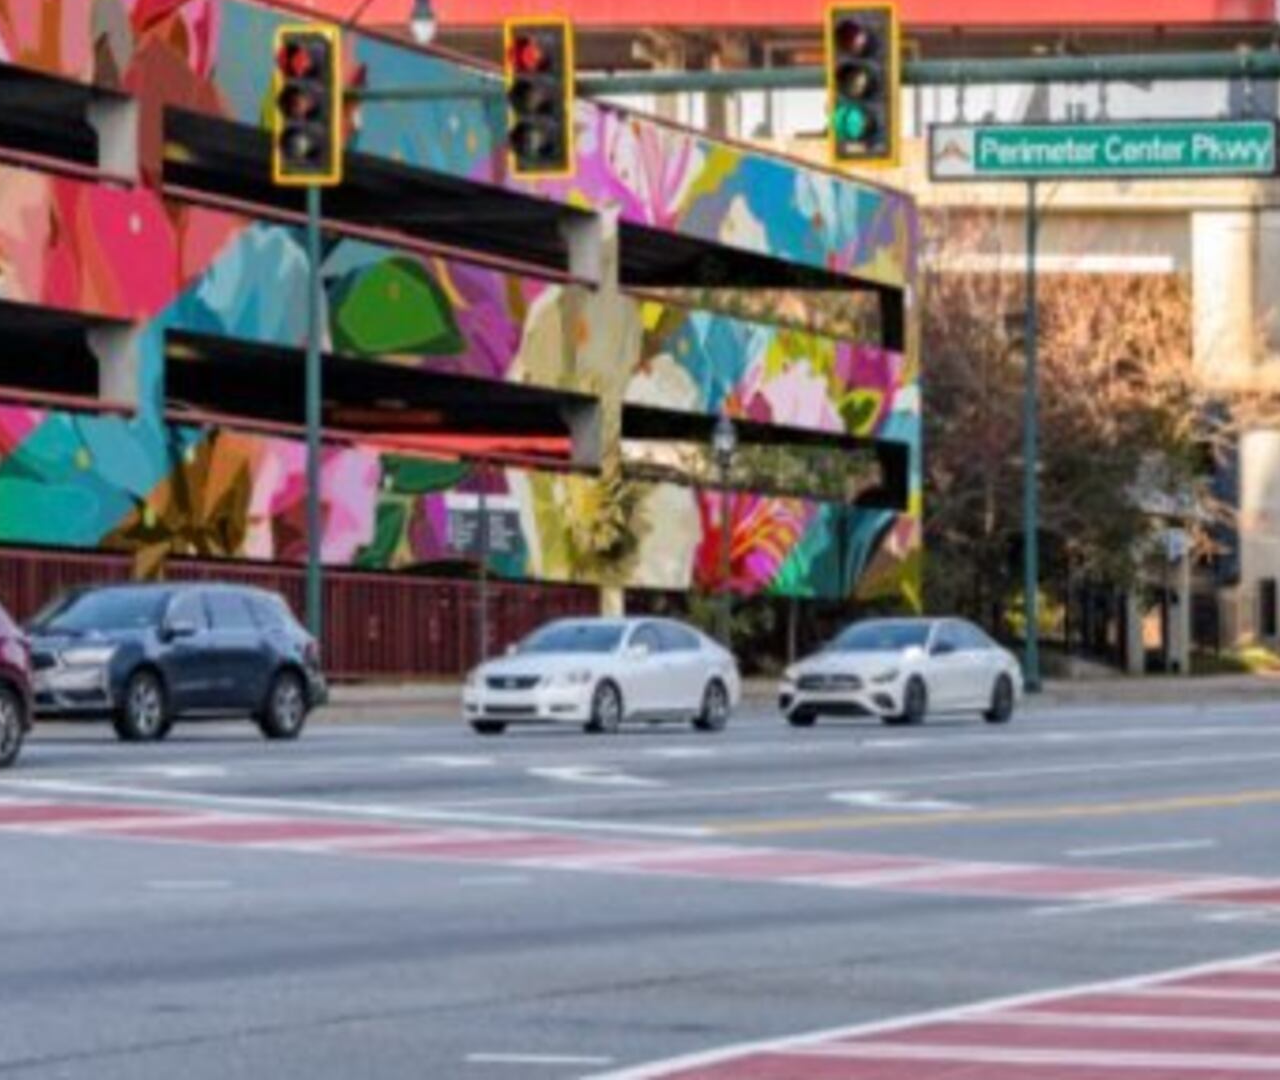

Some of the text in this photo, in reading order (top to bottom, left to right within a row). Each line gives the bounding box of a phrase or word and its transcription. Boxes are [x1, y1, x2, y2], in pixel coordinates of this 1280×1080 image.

[981, 132, 1270, 167] Perimeter Center Pkwy
